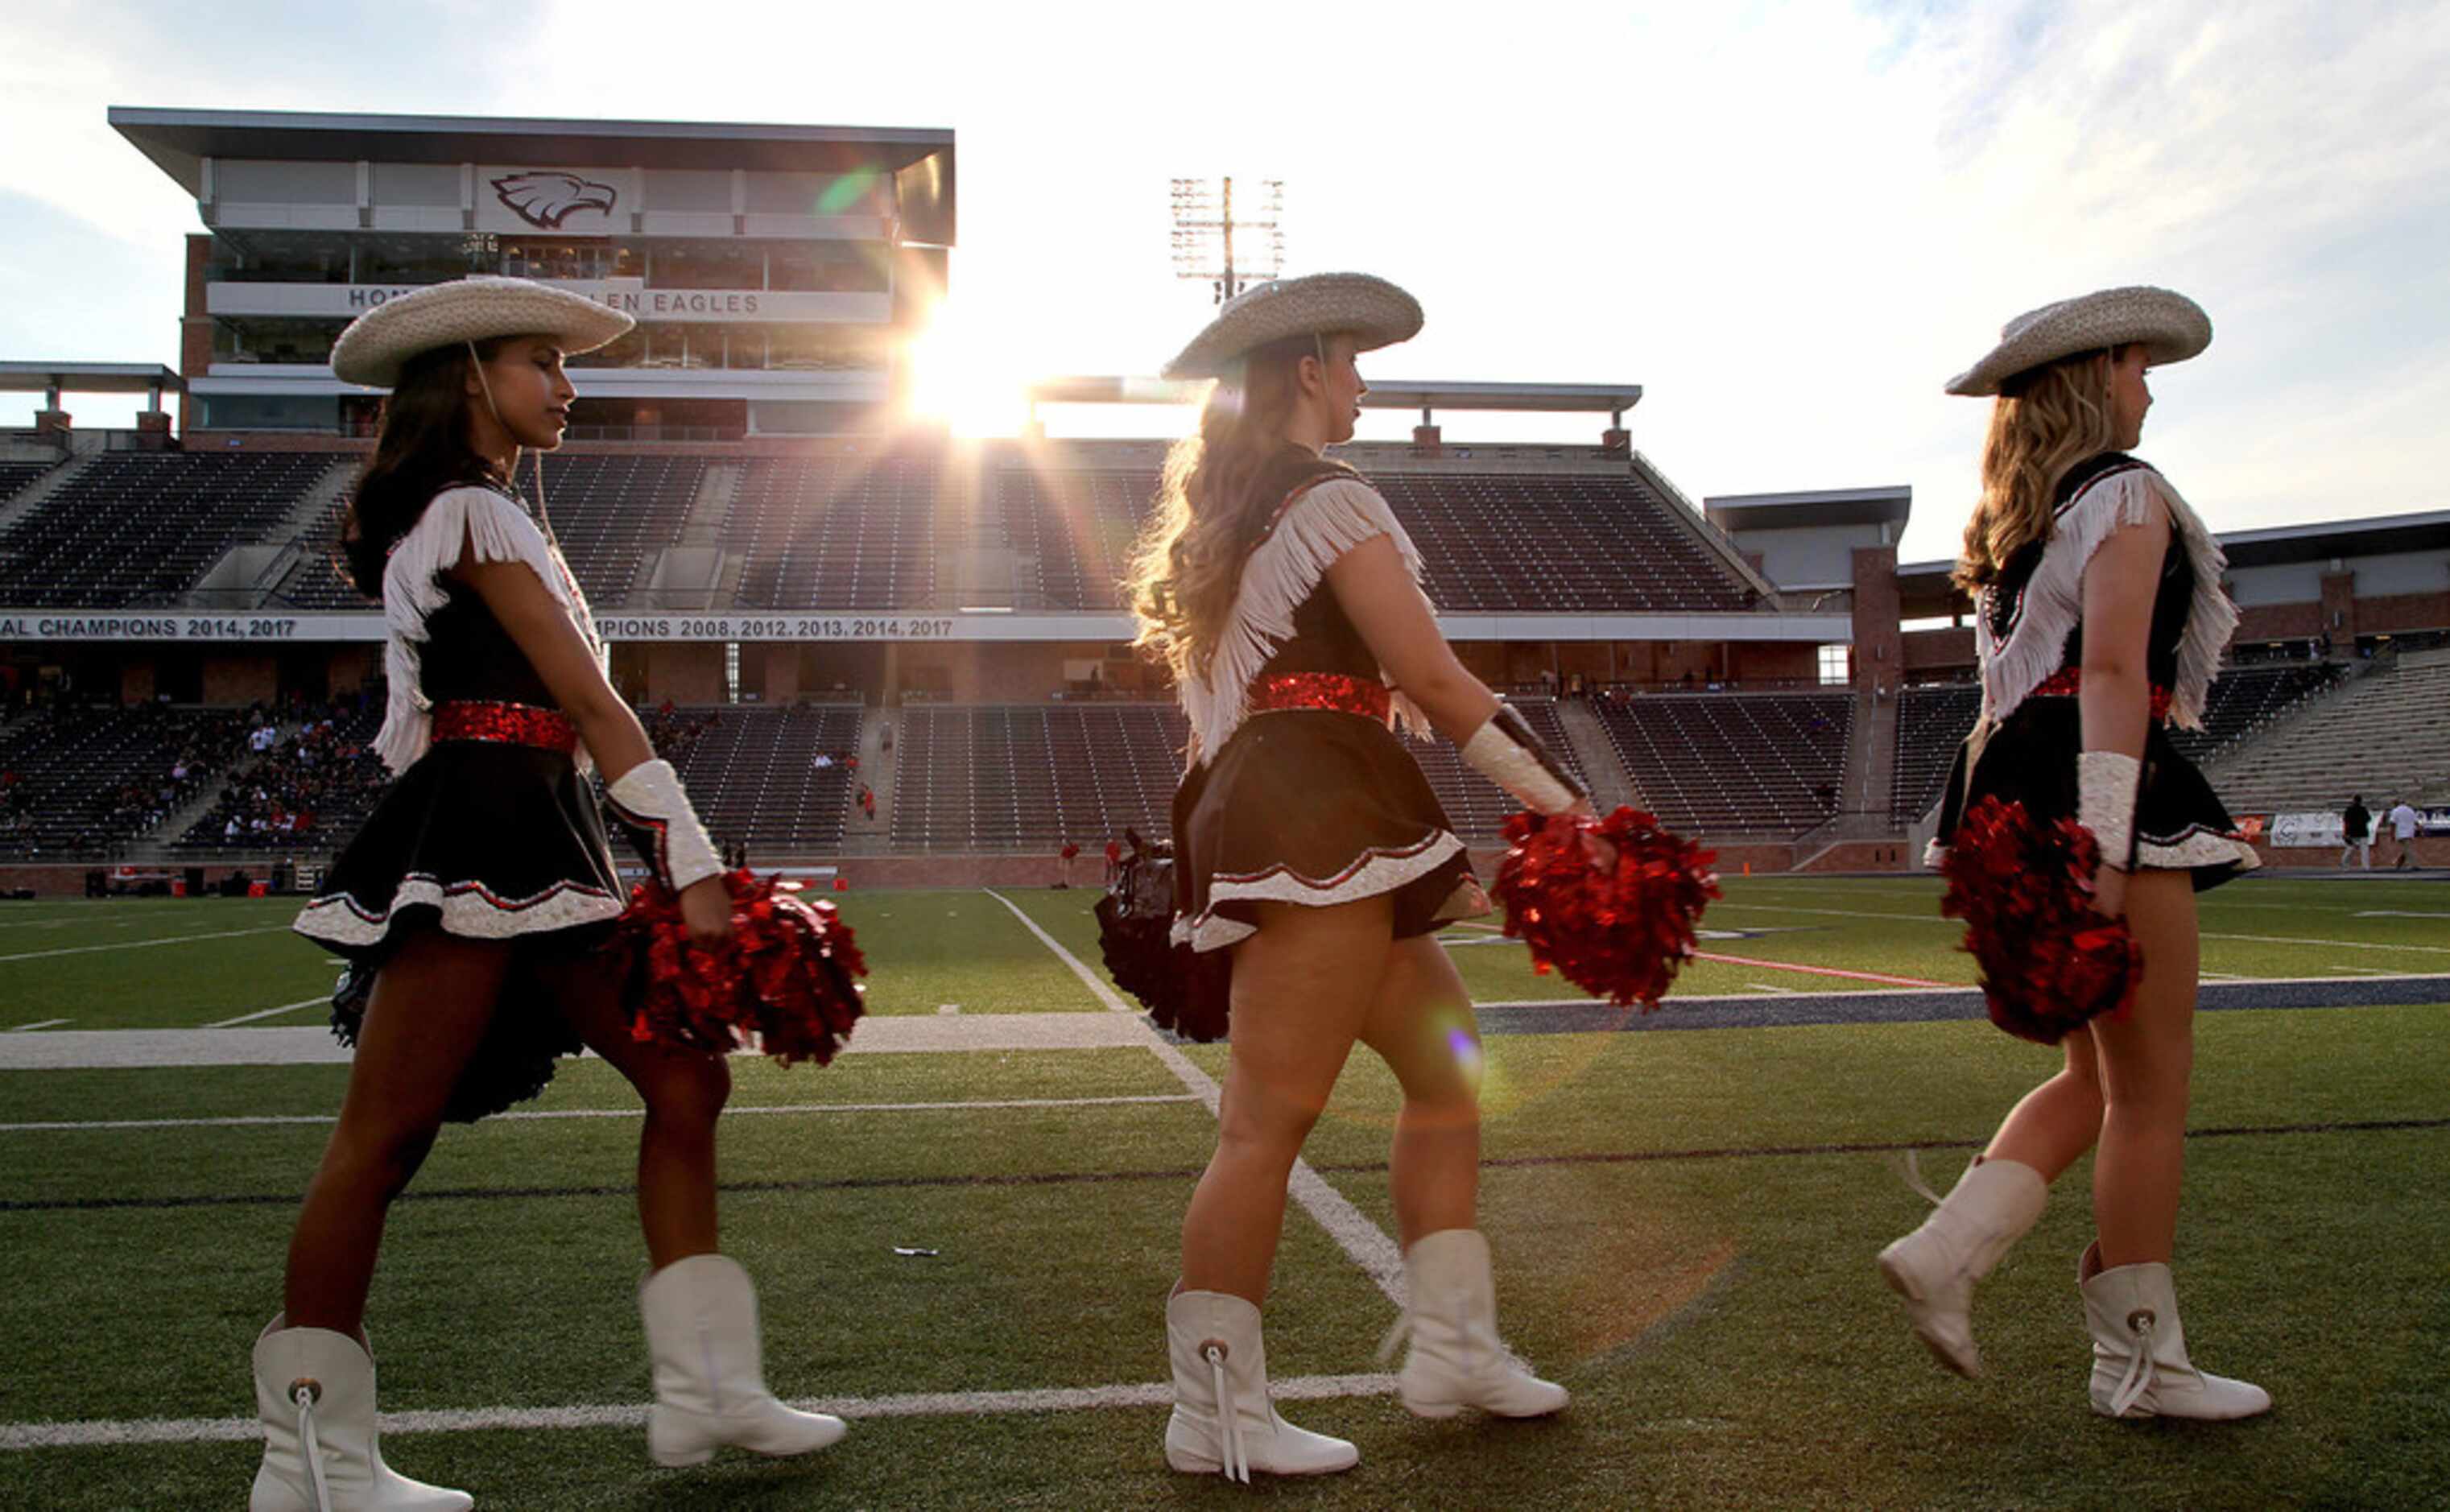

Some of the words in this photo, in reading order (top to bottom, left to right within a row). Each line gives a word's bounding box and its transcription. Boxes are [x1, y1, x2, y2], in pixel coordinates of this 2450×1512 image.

[349, 289, 409, 306] HO
[589, 293, 641, 311] EN
[654, 294, 759, 312] EAGLES
[39, 618, 177, 636] CHAMPIONS
[250, 619, 296, 637] 2017
[910, 620, 953, 637] 2017
